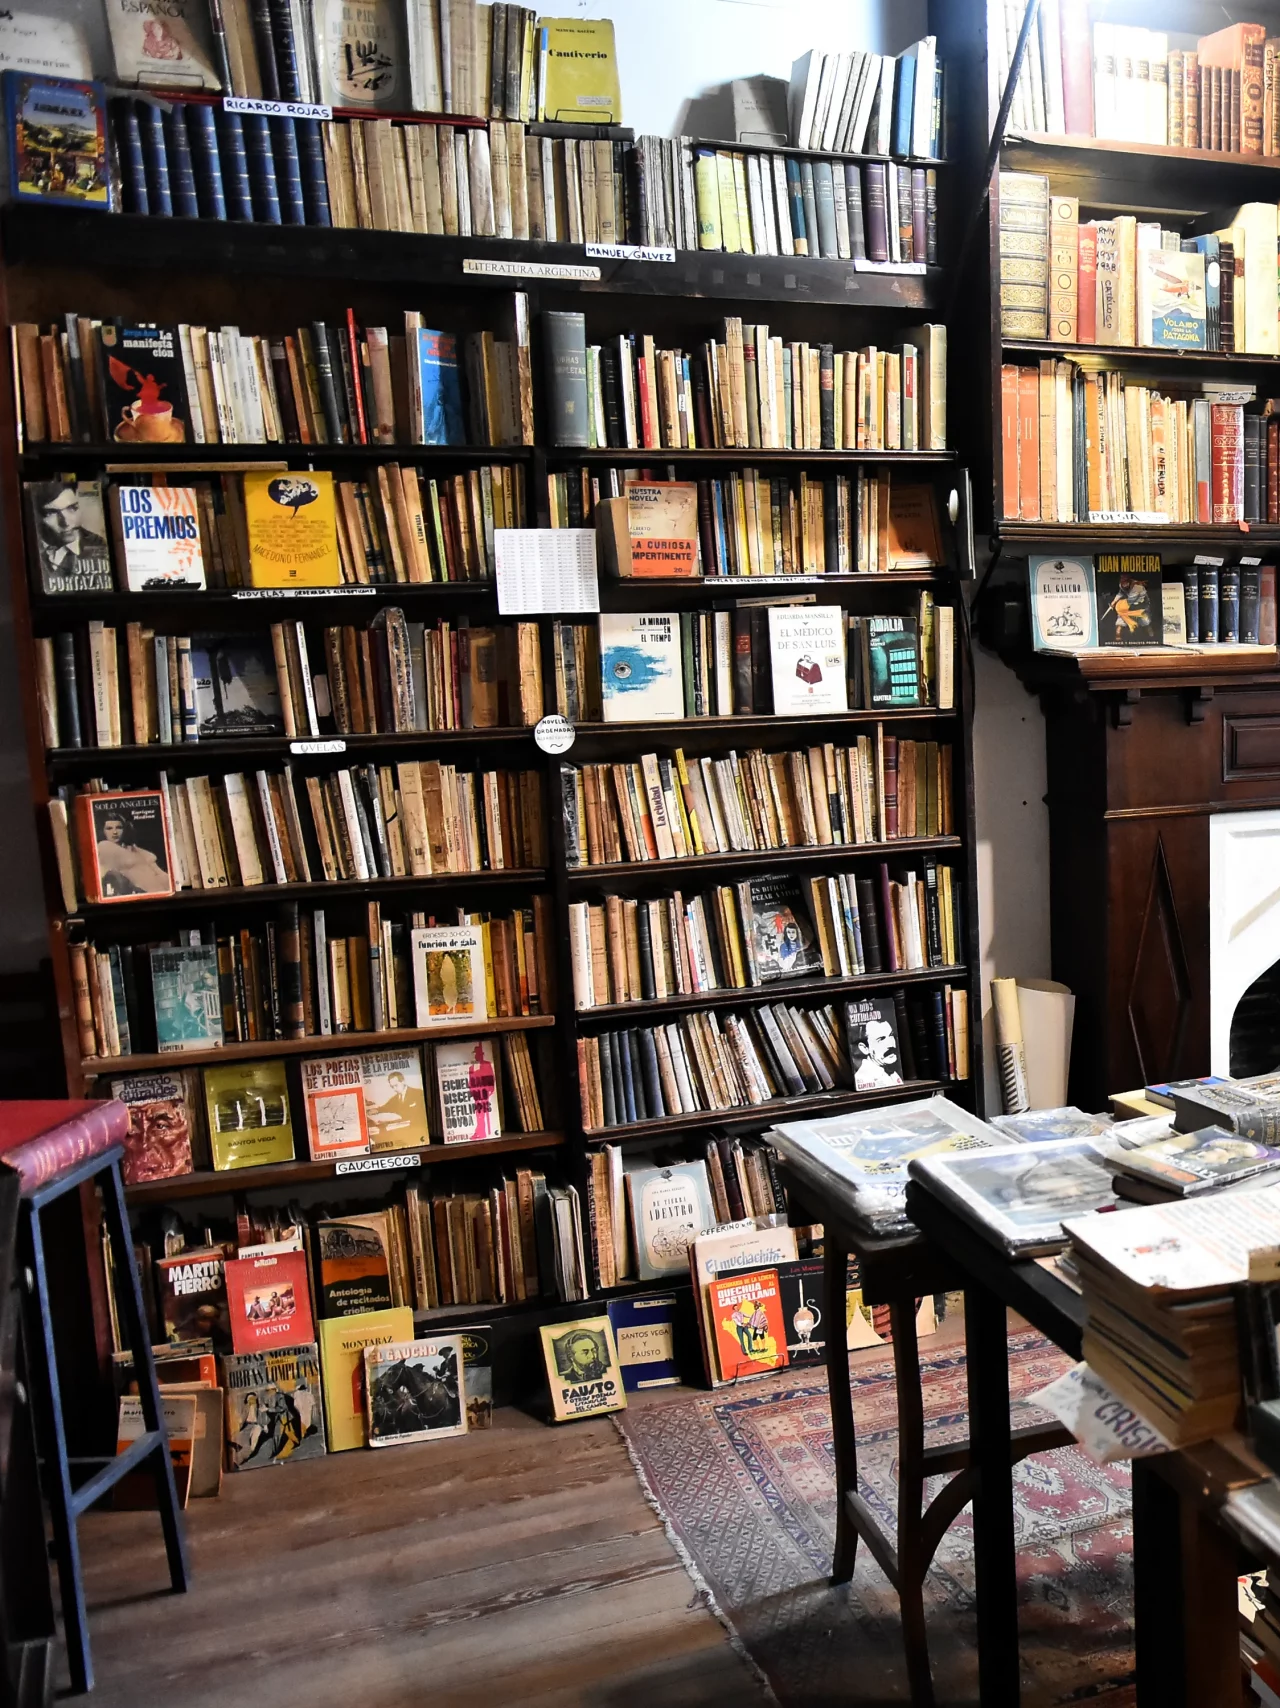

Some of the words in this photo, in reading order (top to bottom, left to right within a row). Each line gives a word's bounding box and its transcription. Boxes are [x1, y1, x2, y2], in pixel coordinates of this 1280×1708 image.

[548, 48, 608, 61] Cautiverio
[226, 100, 281, 113] RICARDO
[287, 105, 329, 118] ROJAS
[587, 246, 629, 258] MANUEL
[467, 262, 533, 275] LITERATURA
[536, 267, 597, 280] ARGENTINA
[159, 330, 173, 340] La
[123, 338, 174, 349] manifesta
[629, 488, 662, 497] NUESTRA
[120, 488, 151, 514] LOS
[629, 496, 658, 505] NOVELA
[123, 515, 196, 540] PREMIOS
[646, 541, 692, 550] CURIOSA
[251, 544, 298, 565] MACEDONIO
[75, 557, 111, 574] JULIO
[1097, 555, 1118, 572] JUAN
[1119, 555, 1161, 572] MOREIRA
[238, 590, 286, 598] NOVELAS
[639, 617, 647, 626] LA
[648, 617, 671, 626] MIRADA
[869, 618, 904, 633] AMALIA
[663, 625, 672, 635] EN
[779, 627, 792, 638] EL
[641, 634, 647, 643] EL
[650, 634, 672, 643] TIEMPO
[778, 640, 789, 650] DE
[790, 640, 812, 650] SAN
[813, 639, 838, 650] LUIS
[537, 727, 574, 735] ORDENADAS
[418, 940, 448, 950] función
[450, 939, 459, 948] de
[460, 937, 477, 949] gala
[305, 1064, 324, 1079] LOS
[325, 1059, 360, 1076] POETAS
[122, 1076, 172, 1091] Ricardo
[307, 1077, 318, 1090] DE
[320, 1071, 361, 1088] FLORIDA
[227, 1137, 256, 1149] SANTOS
[256, 1134, 278, 1145] VEGA
[338, 1154, 420, 1173] GAUCHESCOS
[652, 1200, 661, 1208] DE
[664, 1195, 688, 1206] TIERRA
[648, 1202, 695, 1222] ADENTRO
[699, 1221, 740, 1237] CEFERINO
[704, 1257, 720, 1275] El
[718, 1247, 784, 1271] muchachito
[168, 1261, 224, 1283] MARTIN
[173, 1275, 222, 1296] FIERRO
[717, 1283, 762, 1299] QUECHUA
[336, 1297, 349, 1308] de
[350, 1293, 390, 1305] recitados
[718, 1288, 777, 1308] CASTELLANO
[255, 1323, 291, 1338] FAUSTO
[621, 1330, 648, 1341] SANTOS
[650, 1328, 669, 1338] VEGA
[341, 1335, 394, 1351] MONTARAZ
[386, 1344, 438, 1362] GAUCHO
[631, 1348, 662, 1359] FAUSTO
[228, 1367, 266, 1390] OBRAS
[561, 1380, 616, 1400] FAUSTO
